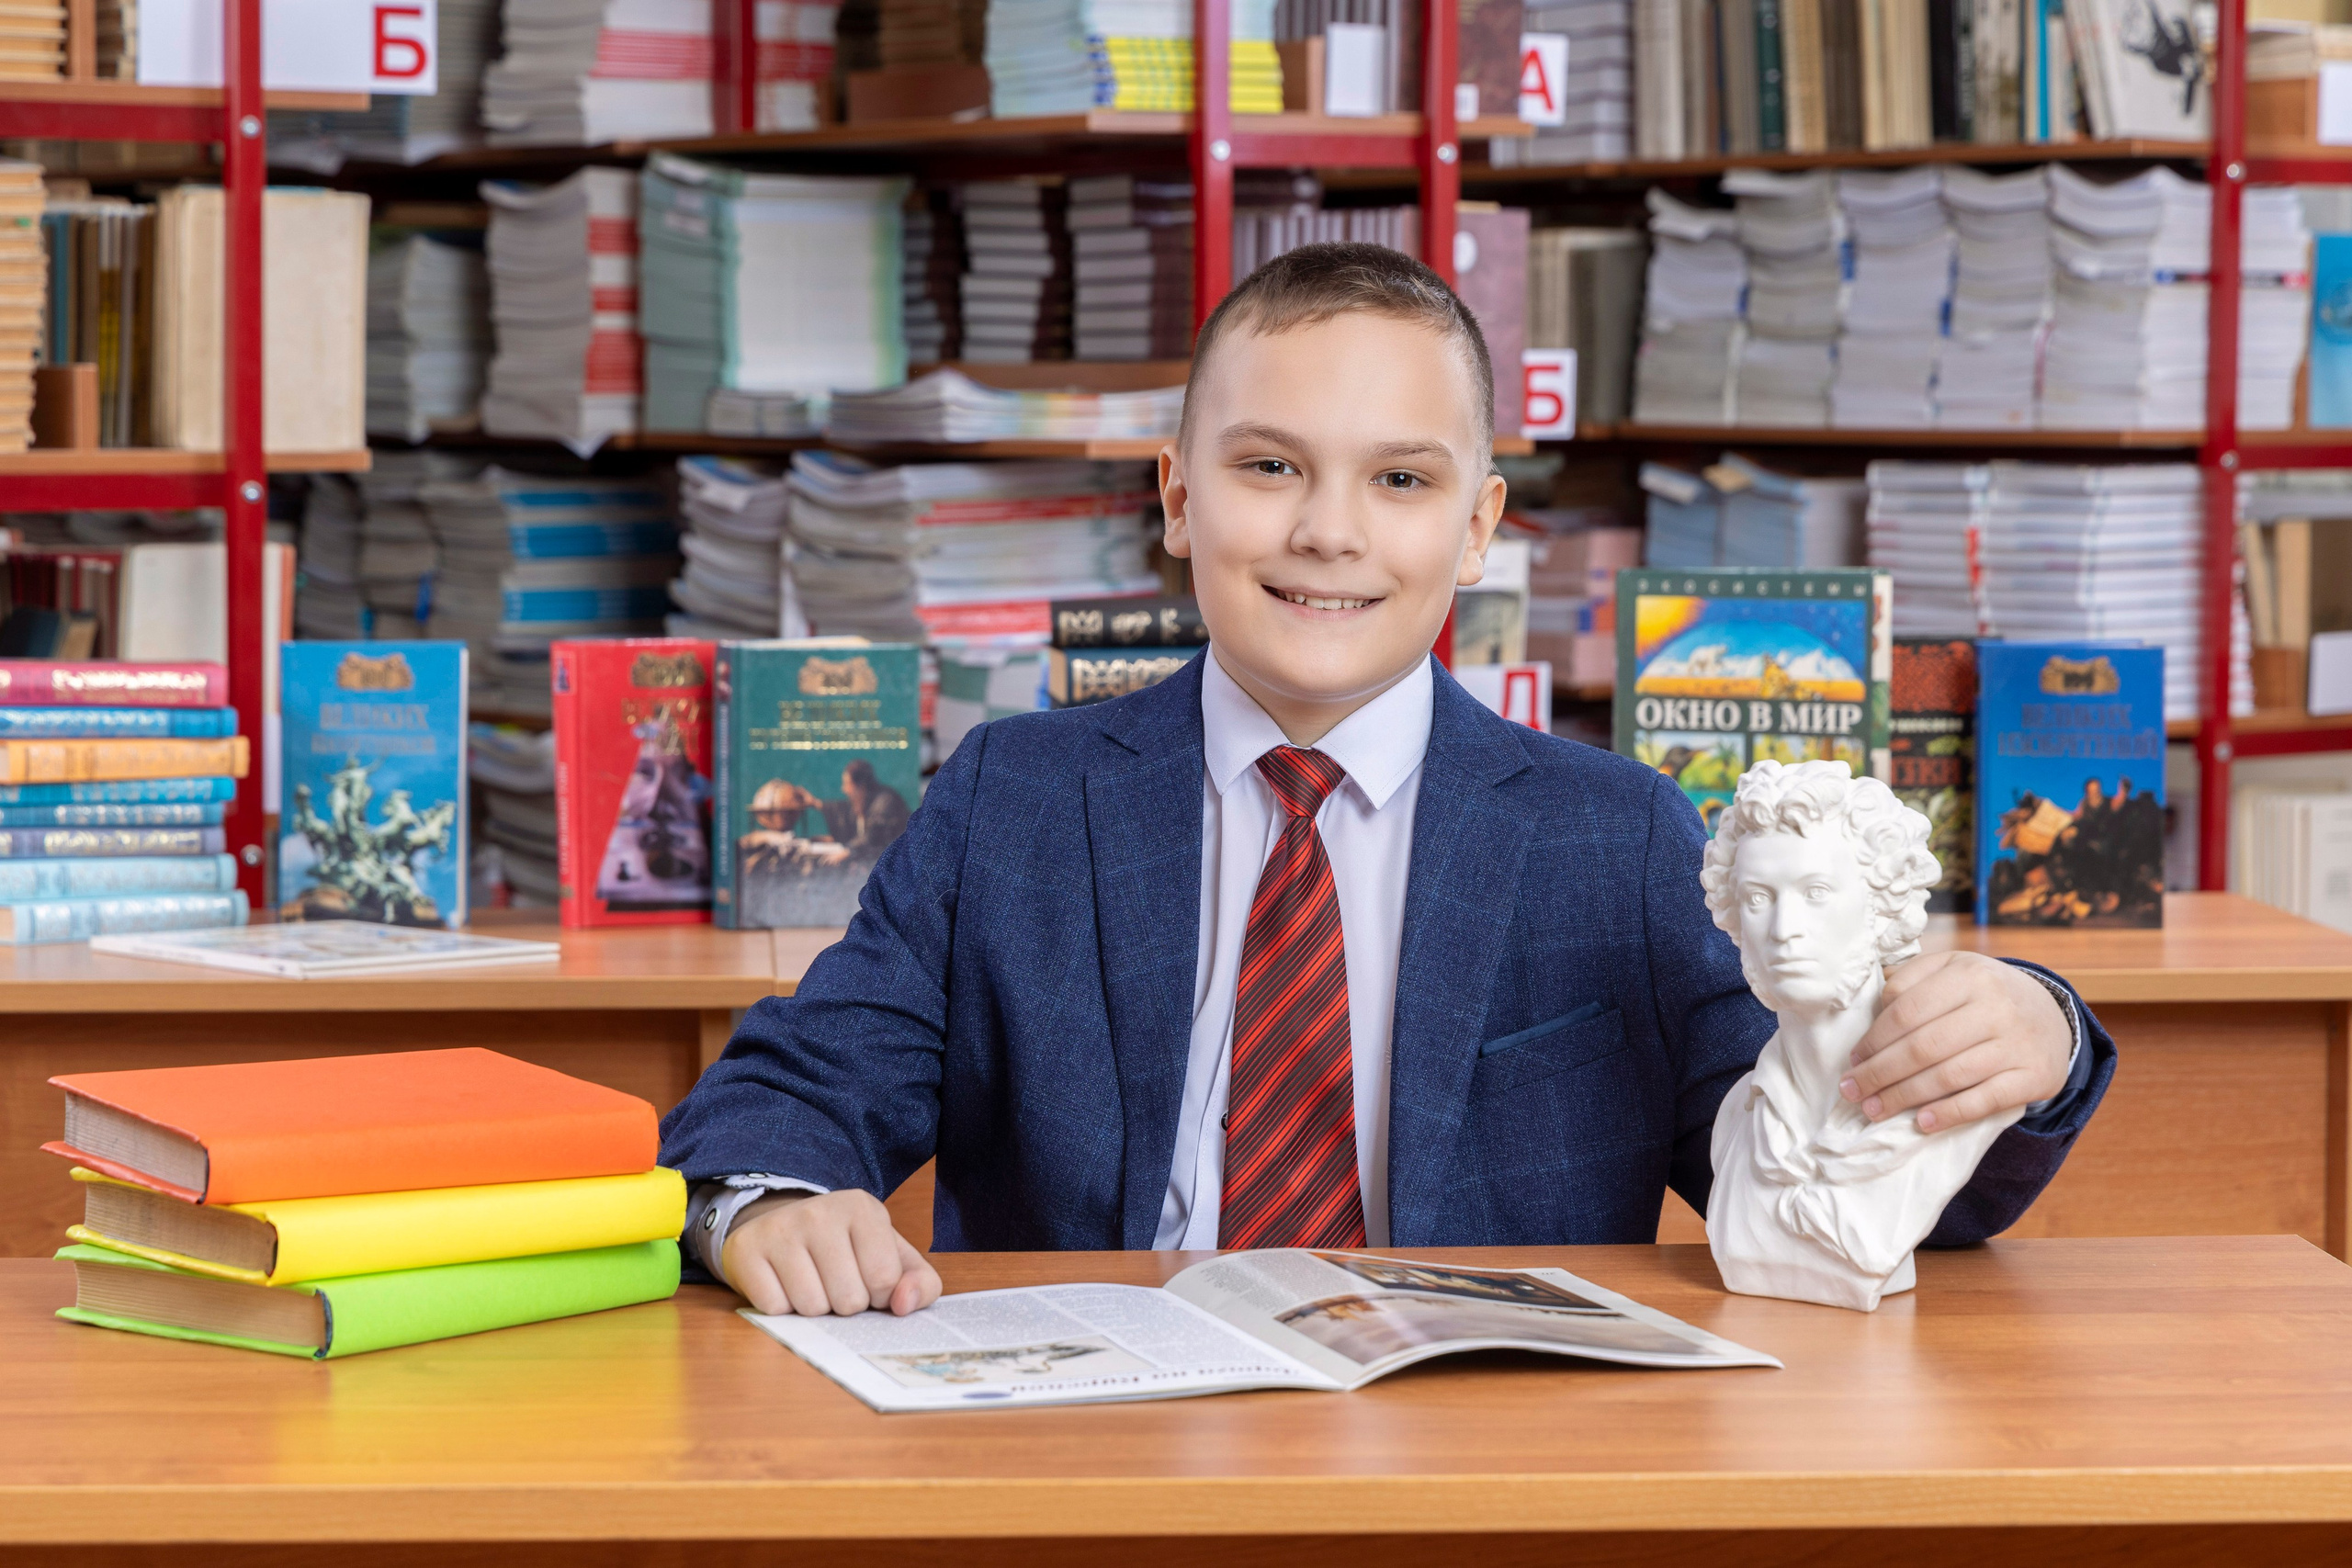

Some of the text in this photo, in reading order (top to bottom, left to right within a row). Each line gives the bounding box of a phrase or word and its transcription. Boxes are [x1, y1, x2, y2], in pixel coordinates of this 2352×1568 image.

[374, 6, 427, 78] Б
[1521, 50, 1554, 111] А
[1522, 364, 1564, 425] Б
[1637, 579, 1867, 597] ЭКОСИСТЕМЫ
[1634, 697, 1864, 735] ОКНО В МИР
